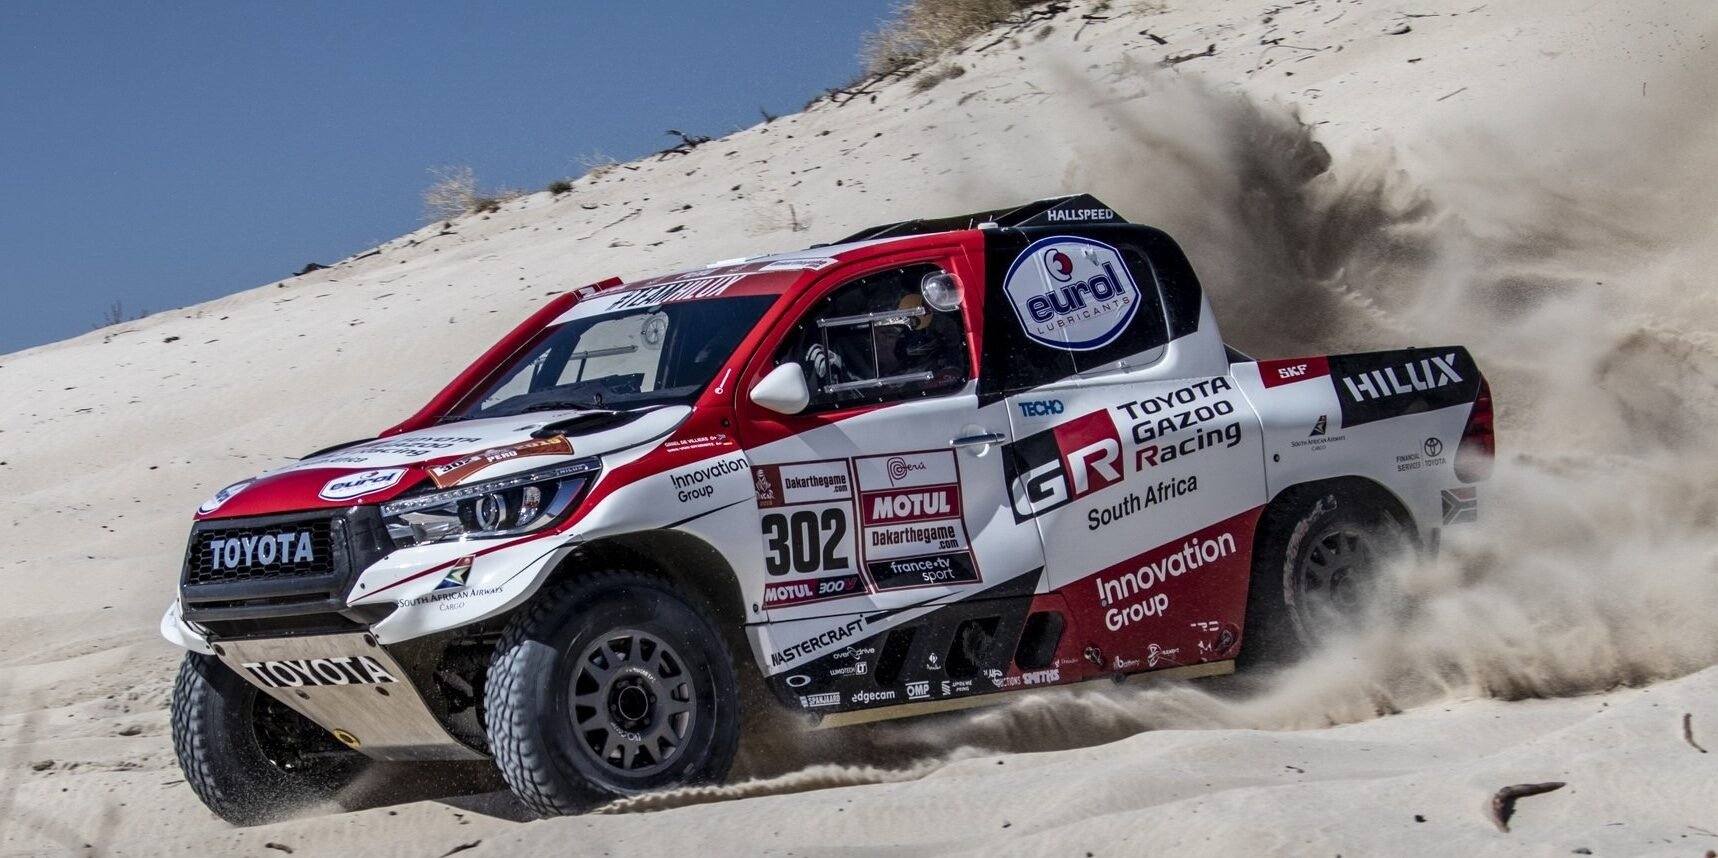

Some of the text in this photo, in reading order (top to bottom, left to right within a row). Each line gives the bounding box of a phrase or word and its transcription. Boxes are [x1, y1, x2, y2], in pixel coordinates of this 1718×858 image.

[1047, 208, 1114, 222] HALLSPEED
[1025, 261, 1126, 325] eurol
[1037, 296, 1131, 334] LUBRICANTS
[1278, 364, 1307, 379] SKF
[1342, 353, 1463, 403] HILUX
[1117, 376, 1232, 420] TOYOTA
[1019, 399, 1064, 417] TECHO
[1132, 400, 1235, 444] GAZOO
[1135, 422, 1242, 472] Racing
[1424, 458, 1447, 467] TOYOTA
[330, 472, 397, 491] eurol
[785, 474, 847, 490] Dakarthegame
[1011, 438, 1122, 515] GR
[677, 485, 714, 502] Group
[833, 483, 848, 493] .com
[873, 491, 951, 520] MOTUL
[1088, 474, 1199, 531] South Africa
[762, 508, 849, 576] 302
[872, 525, 956, 547] Dakarthegame
[938, 539, 959, 550] .com
[210, 531, 314, 570] TOYOTA
[923, 568, 955, 583] sport
[399, 597, 430, 608] SOUTH
[430, 591, 469, 604] AFRICAN
[765, 584, 814, 602] MOTUL
[439, 602, 465, 612] CARGO
[1105, 593, 1169, 632] Group
[772, 616, 864, 667] MASTERCRAFT
[243, 655, 398, 688] TOYOTA
[856, 663, 867, 674] LT
[852, 689, 896, 704] edgecam
[906, 684, 930, 697] OMP
